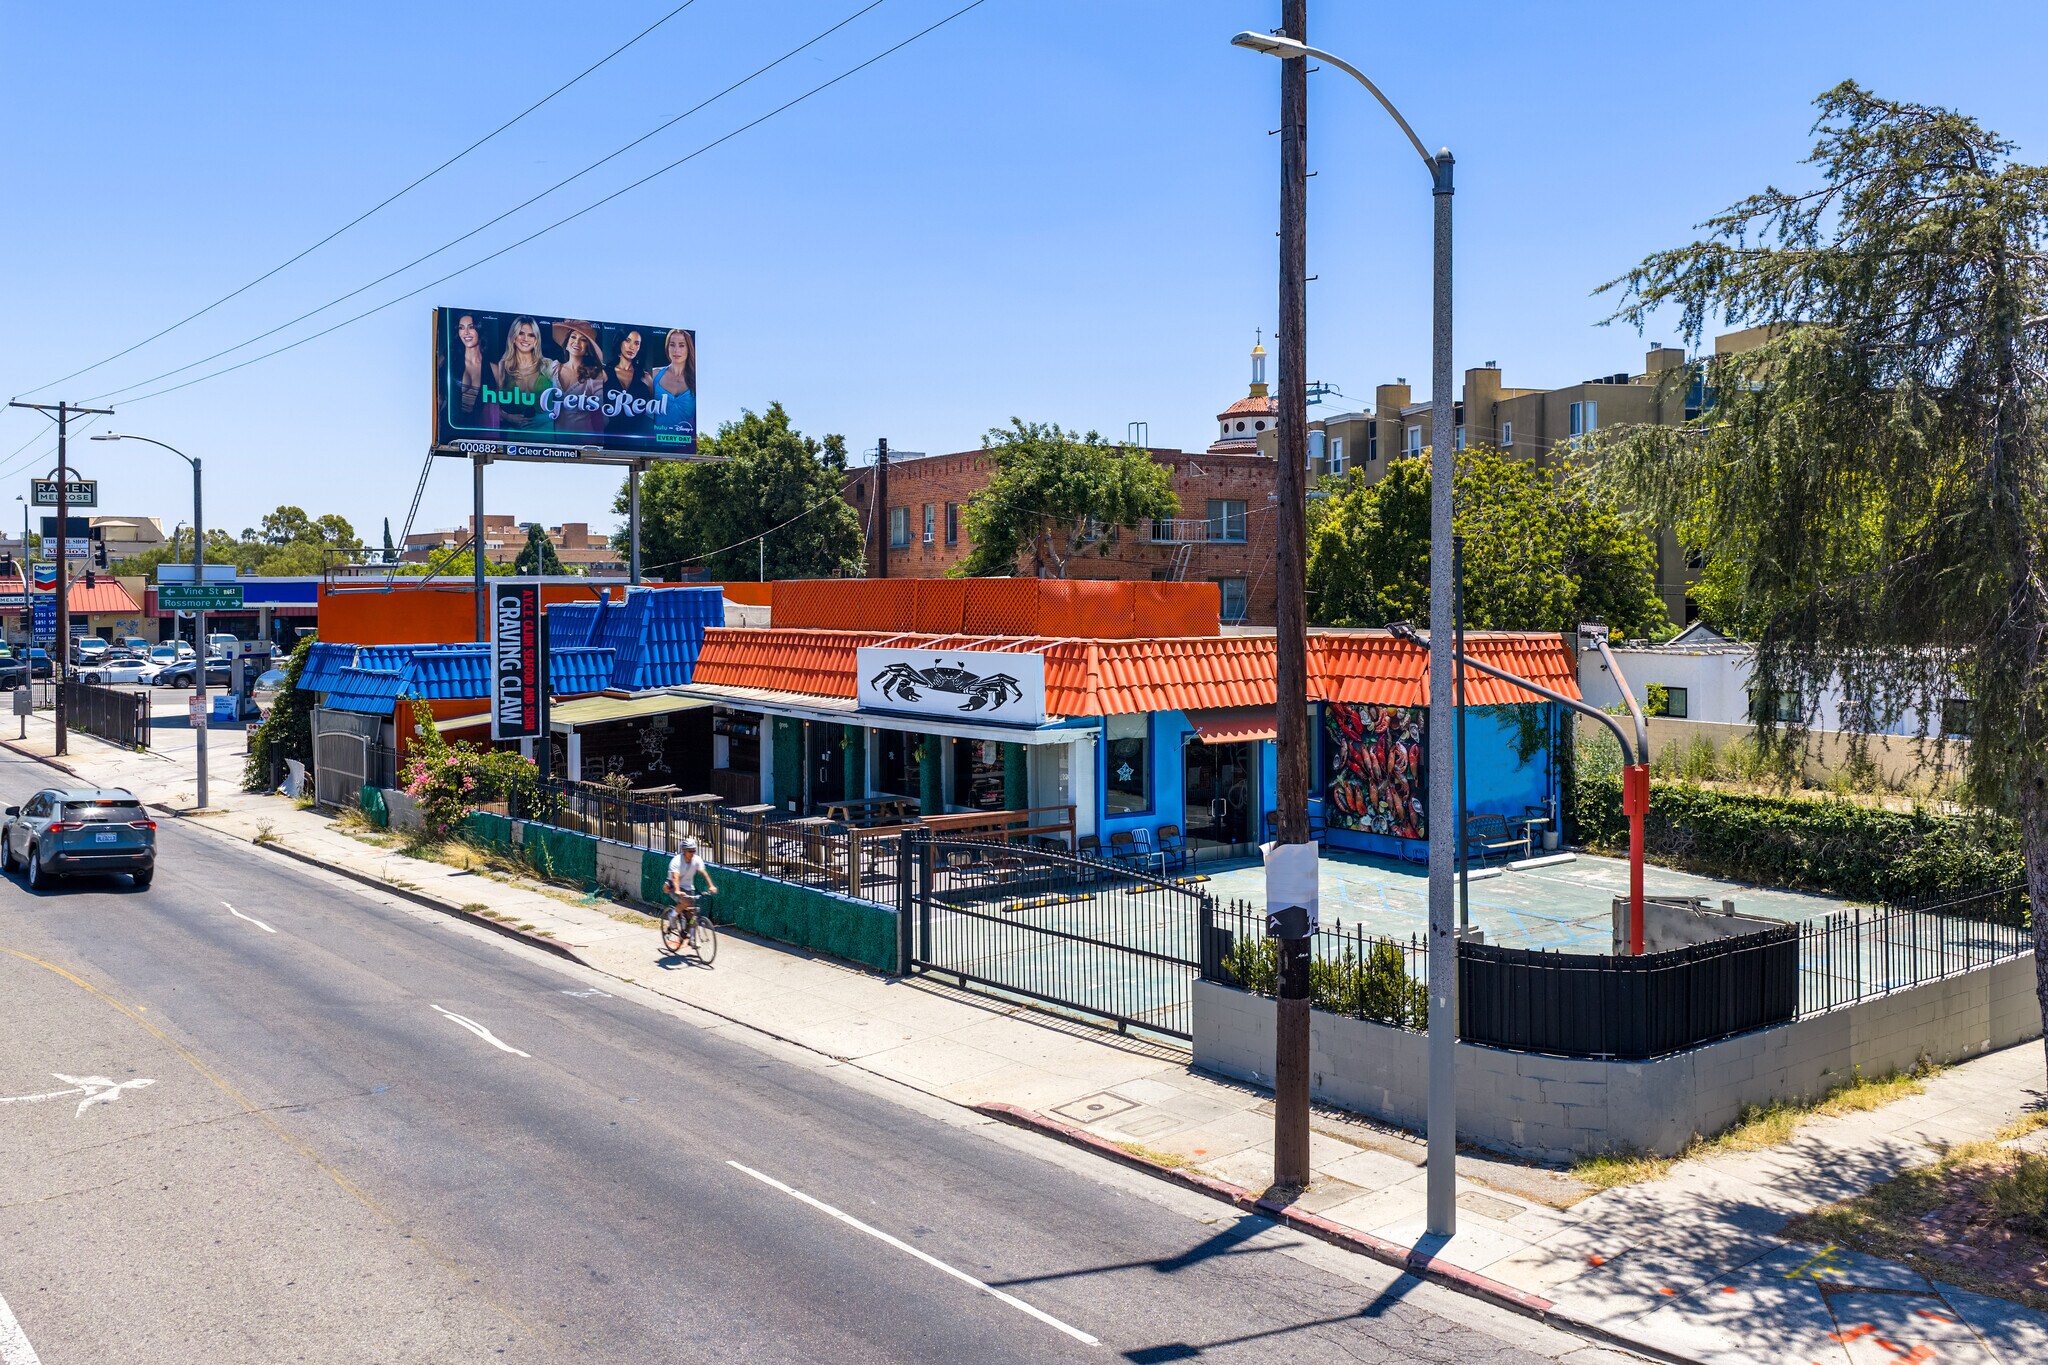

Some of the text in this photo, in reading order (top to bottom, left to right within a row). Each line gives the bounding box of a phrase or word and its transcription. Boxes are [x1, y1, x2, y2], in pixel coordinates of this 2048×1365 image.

[482, 384, 668, 420] hulu Gets Real
[460, 442, 497, 453] 000882
[518, 446, 578, 458] Clear Channel
[183, 587, 219, 595] Vine St
[164, 599, 227, 607] Rossmore Av
[499, 596, 523, 725] CRAVING CLAW
[522, 589, 535, 731] AYCE CAJUN SEAFOOD AND SUSHI
